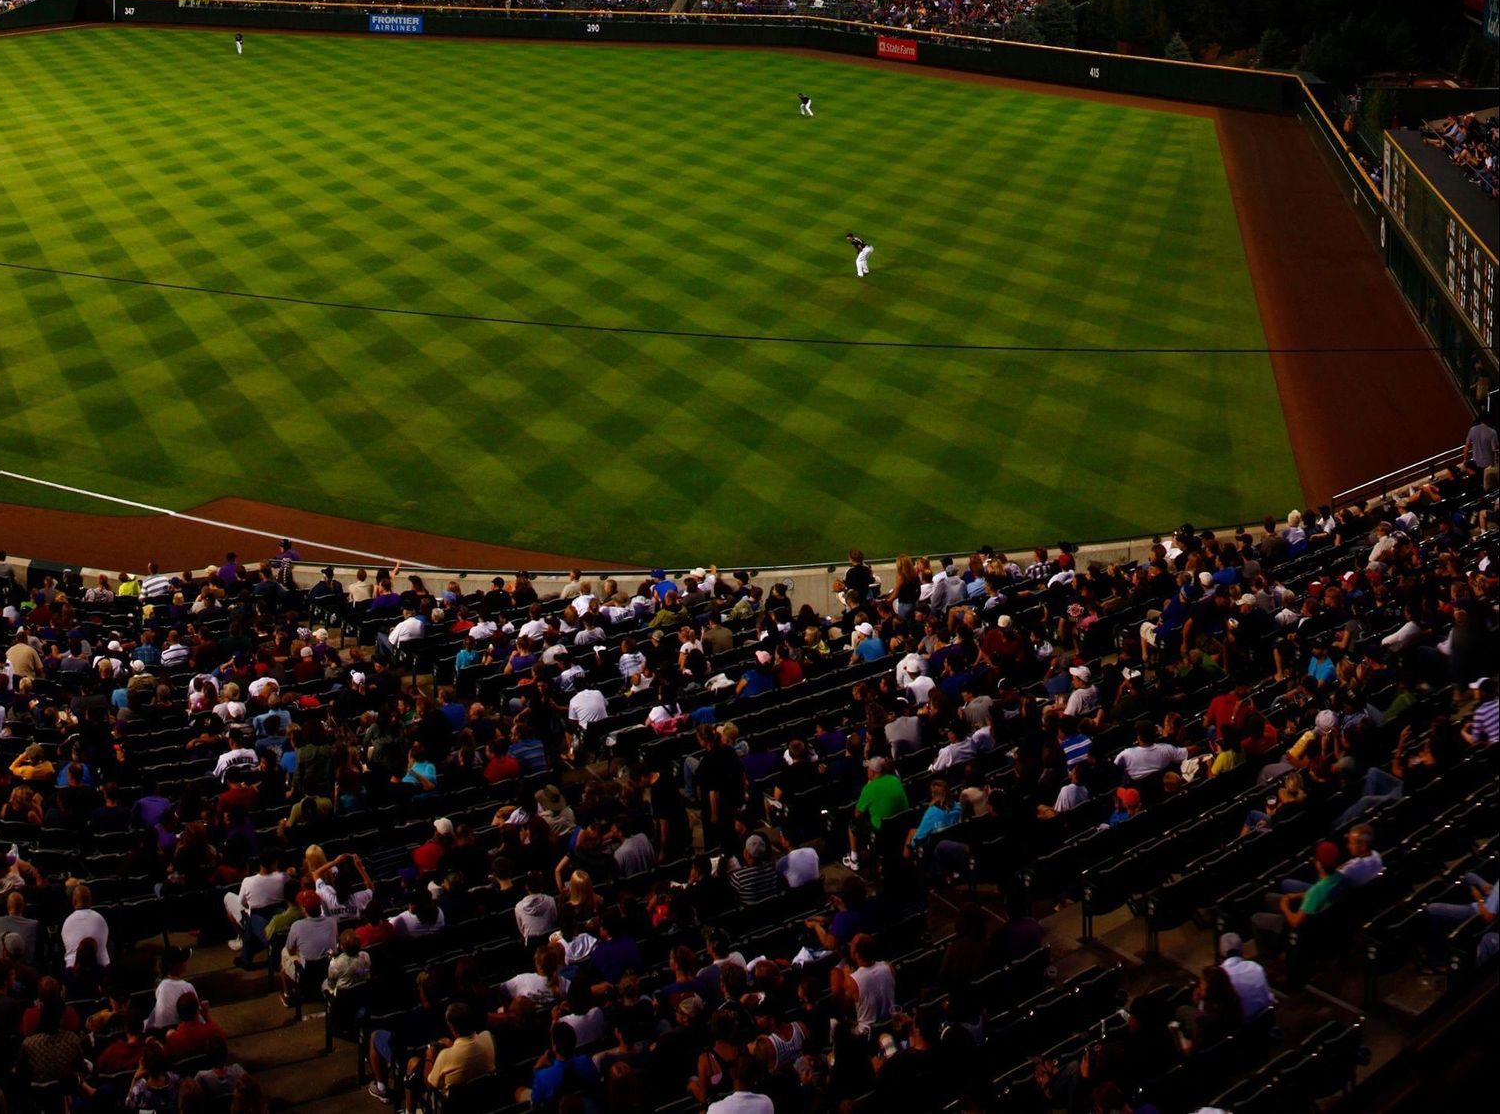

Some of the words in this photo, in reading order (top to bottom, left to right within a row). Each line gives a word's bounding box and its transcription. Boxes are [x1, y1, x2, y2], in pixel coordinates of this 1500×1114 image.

[124, 7, 135, 15] 347
[372, 16, 420, 25] FRONTIER
[375, 24, 417, 32] AIRLINES
[587, 24, 600, 33] 390
[1090, 67, 1099, 78] 415
